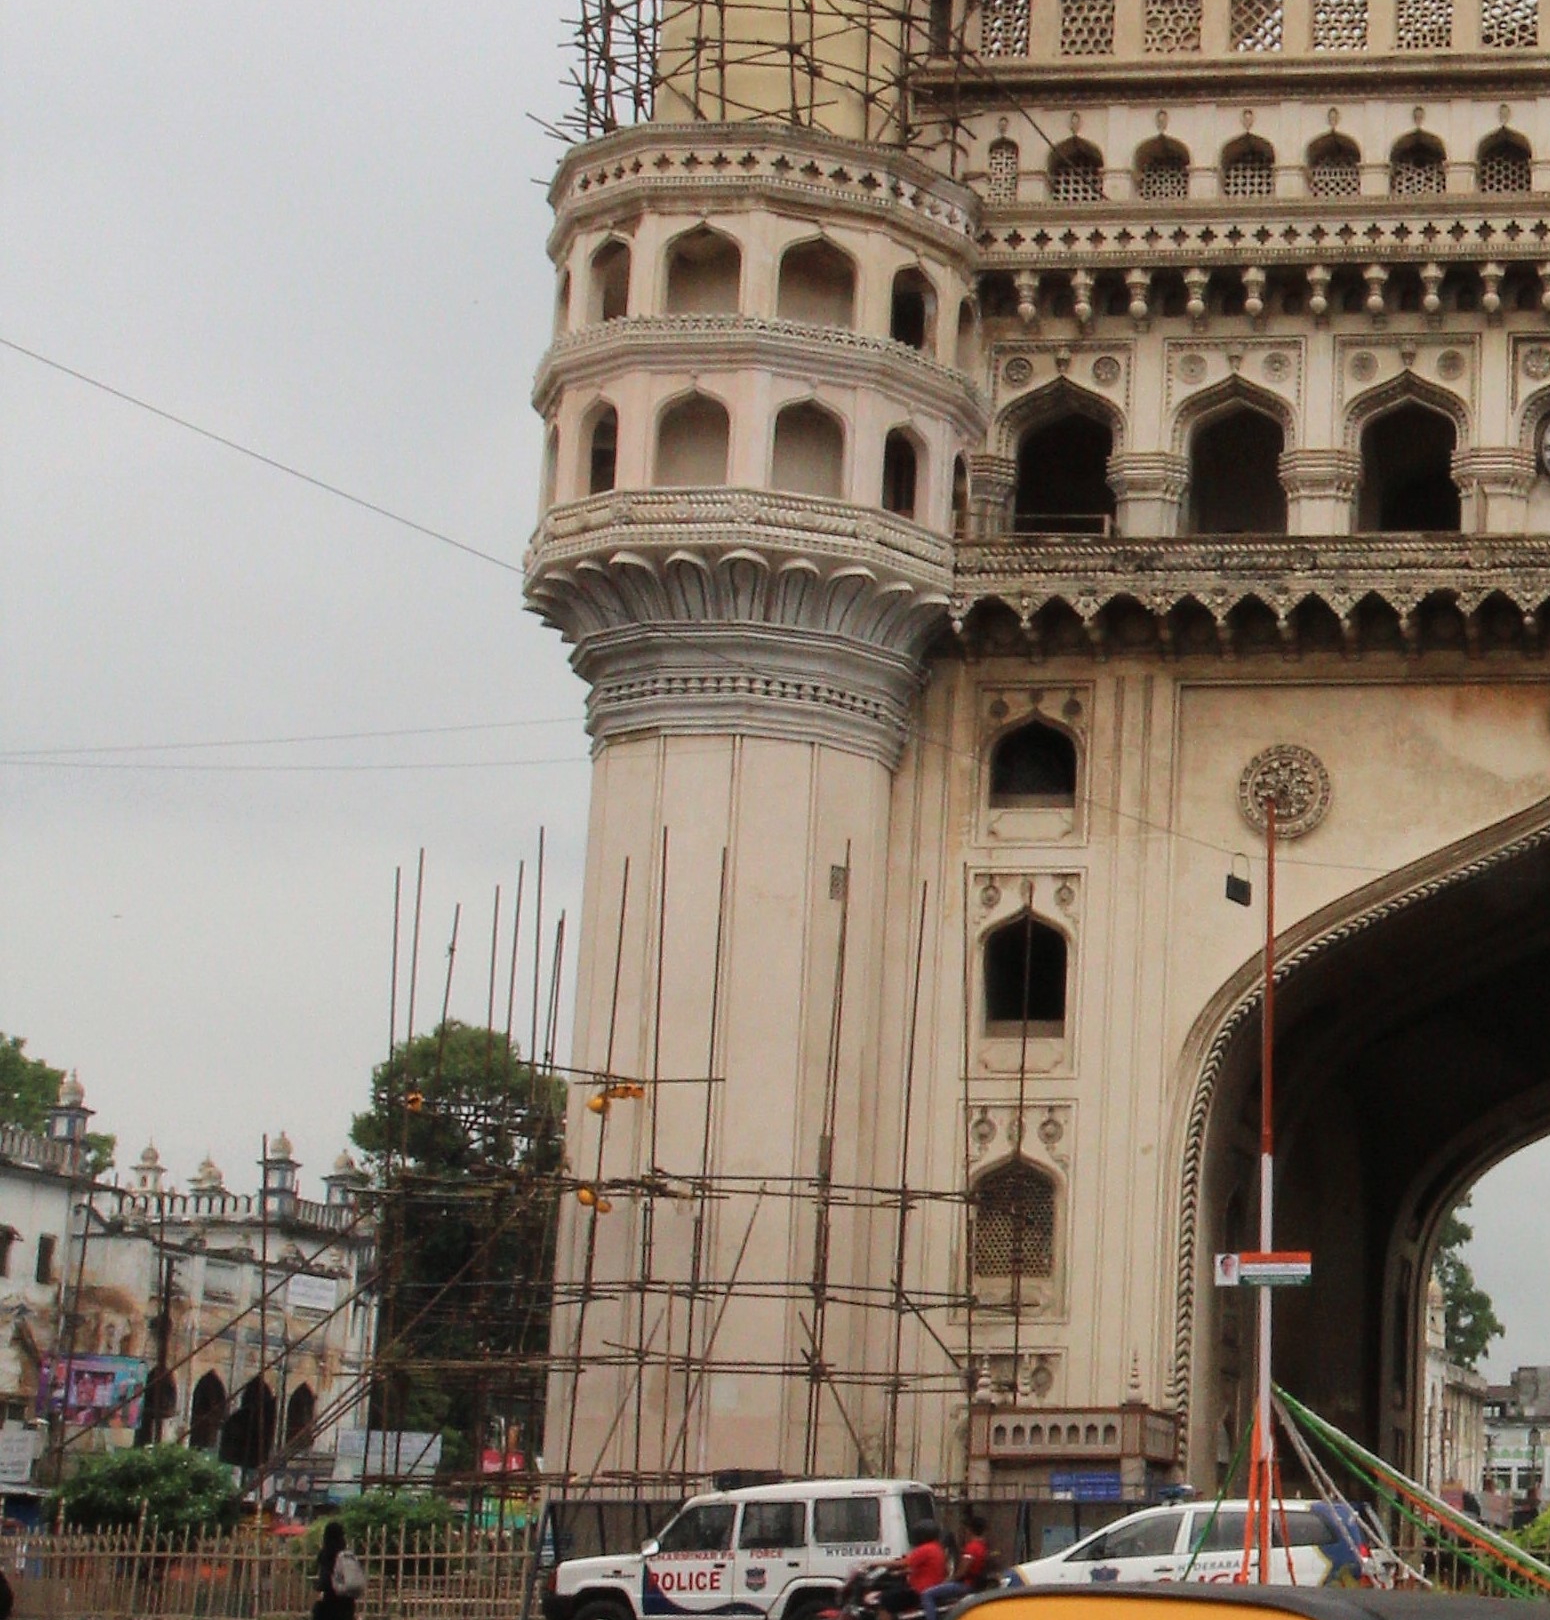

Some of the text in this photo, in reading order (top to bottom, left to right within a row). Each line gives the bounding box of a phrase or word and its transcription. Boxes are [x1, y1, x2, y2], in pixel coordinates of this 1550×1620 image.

[750, 1548, 783, 1559] FORCE
[826, 1545, 891, 1557] HYDERABAD
[1177, 1560, 1242, 1572] HDERABA
[651, 1571, 721, 1592] POLICE
